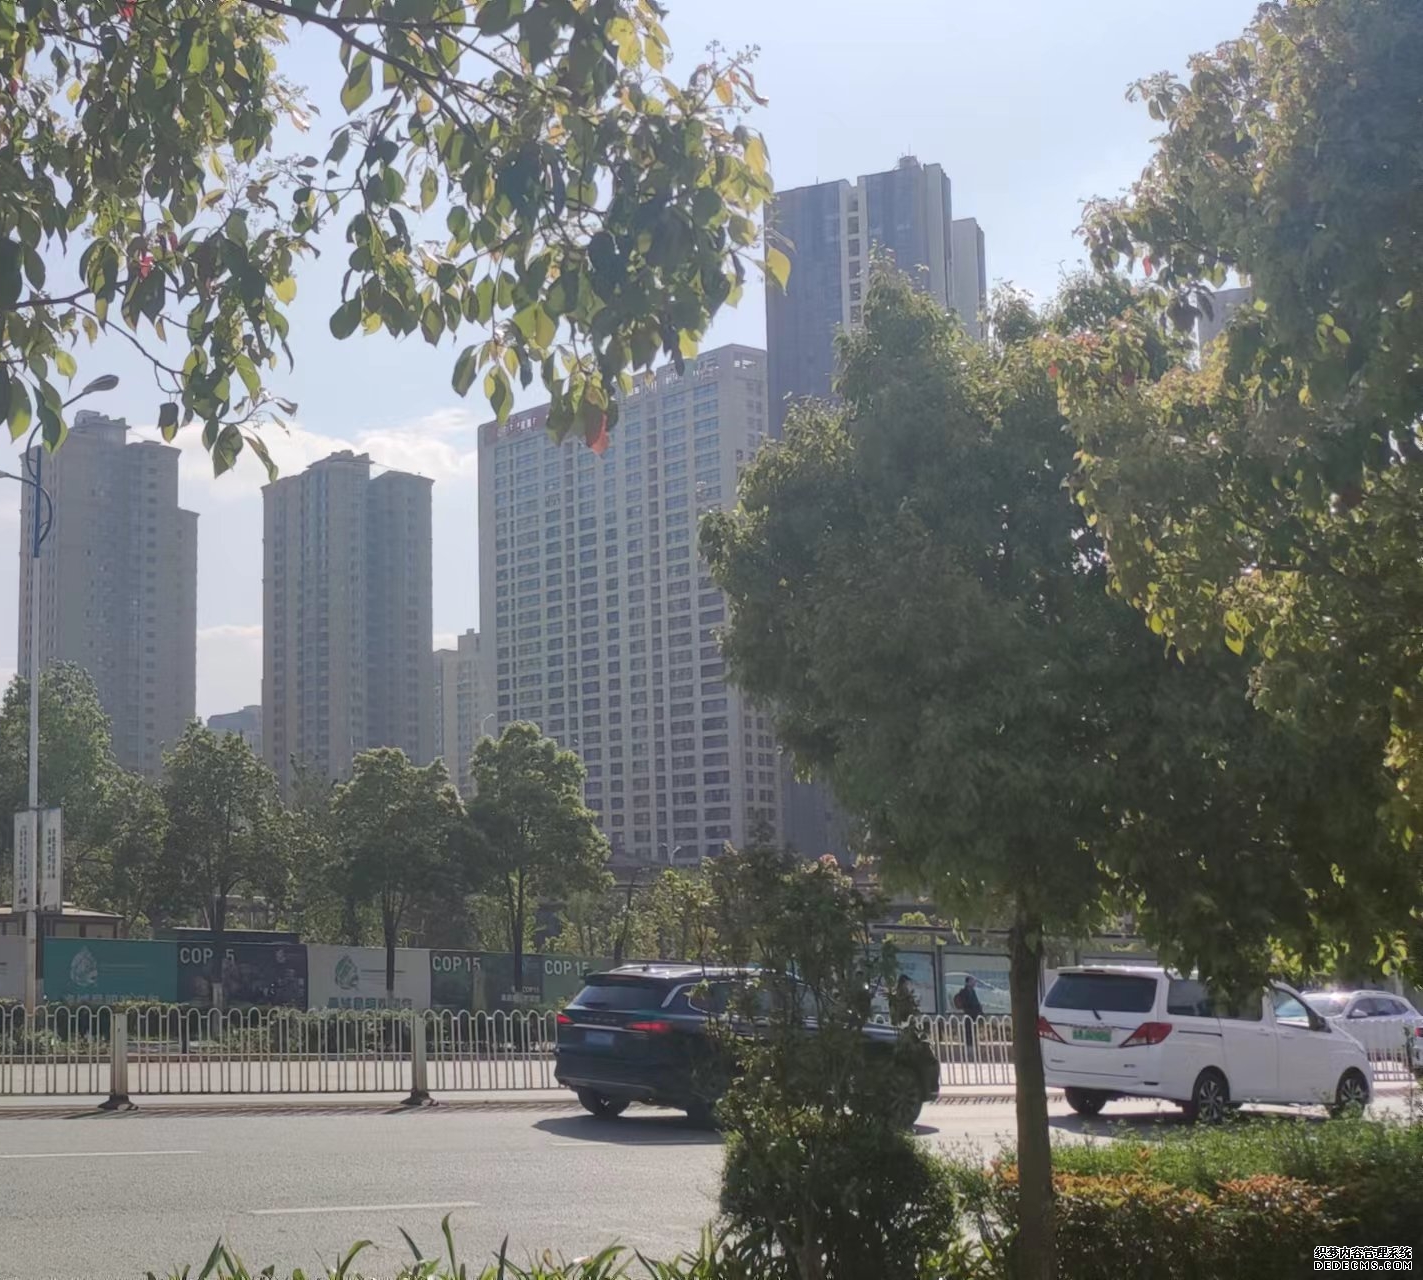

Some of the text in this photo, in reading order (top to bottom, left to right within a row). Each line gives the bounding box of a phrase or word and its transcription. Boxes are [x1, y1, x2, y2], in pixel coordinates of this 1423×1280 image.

[179, 947, 213, 964] COP
[432, 955, 481, 973] COP 15
[544, 959, 572, 975] COP
